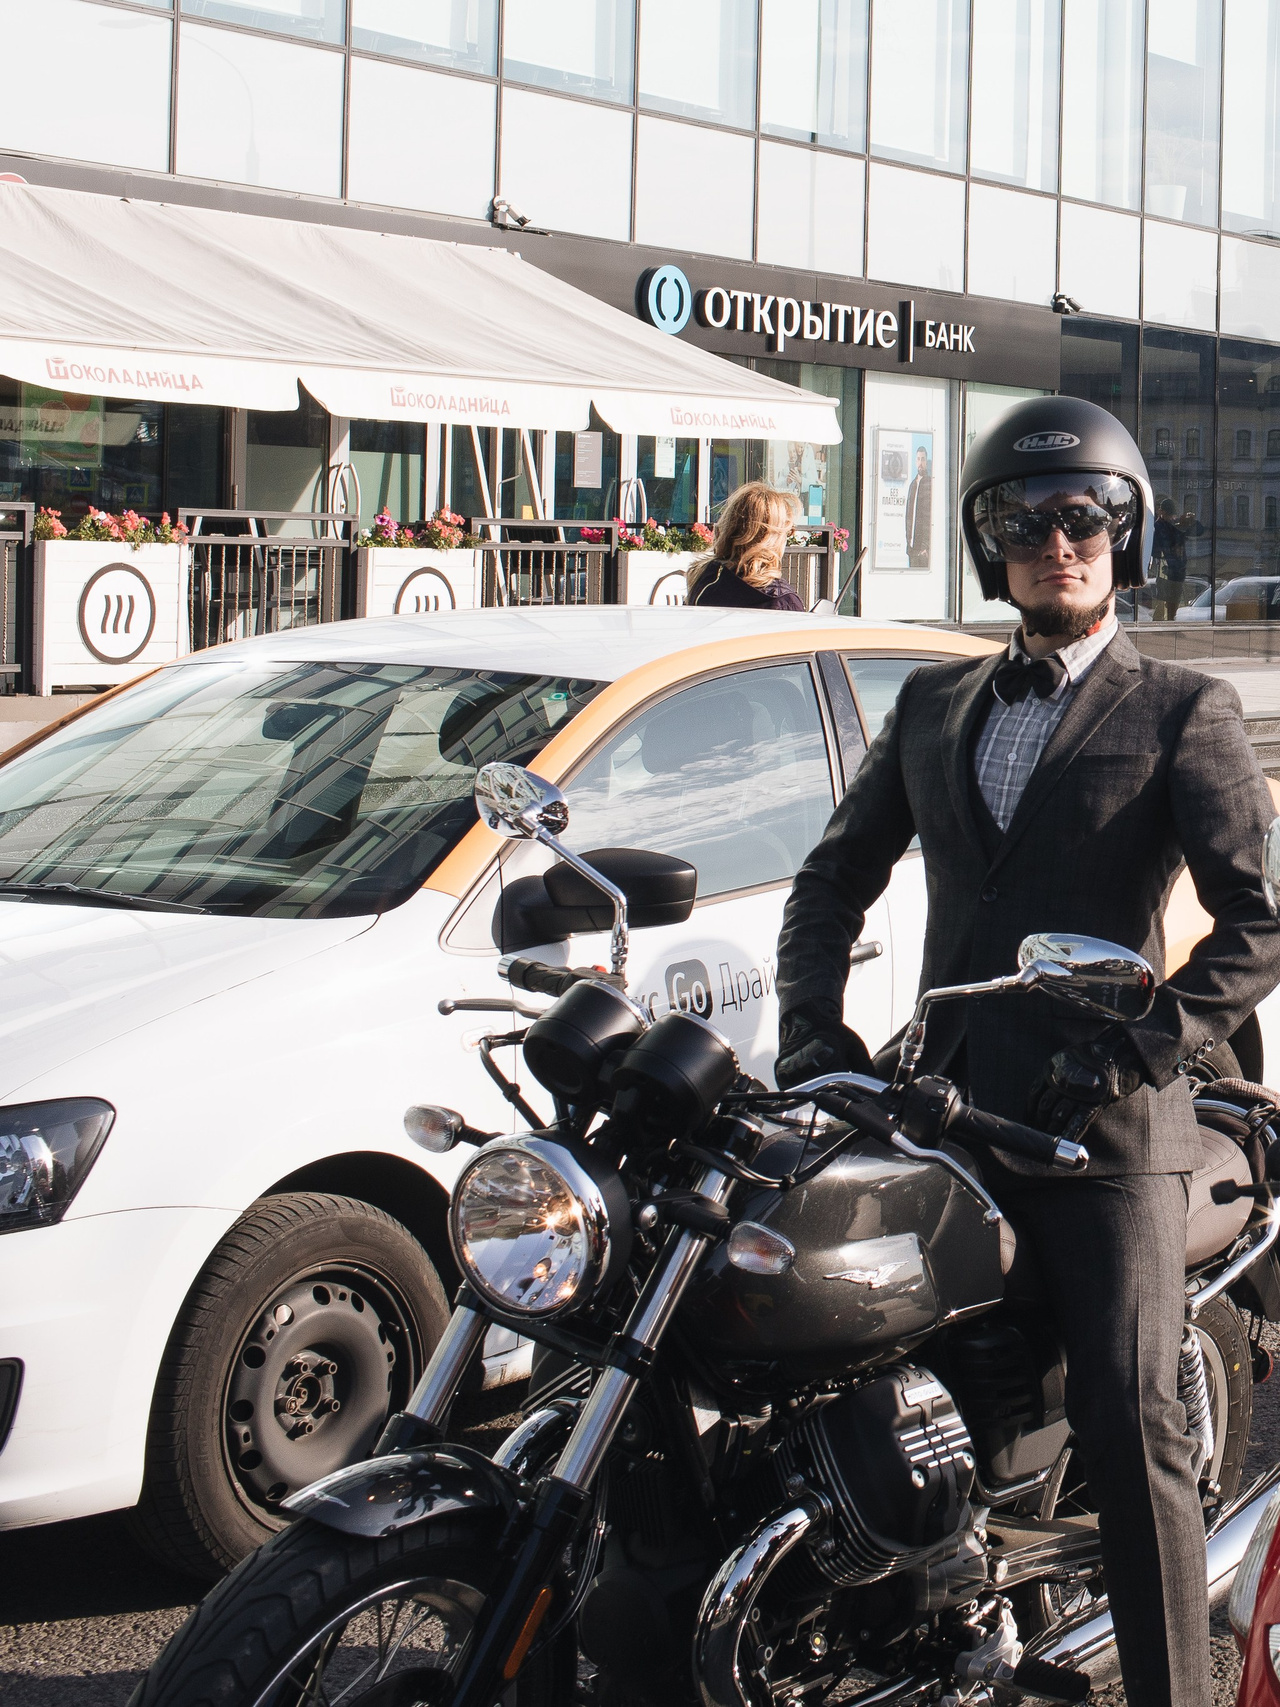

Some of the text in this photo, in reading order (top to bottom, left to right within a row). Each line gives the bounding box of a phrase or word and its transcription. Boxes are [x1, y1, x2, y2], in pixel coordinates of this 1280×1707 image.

[924, 320, 976, 353] БАНК
[1022, 435, 1071, 449] HJC
[672, 972, 707, 1014] Go
